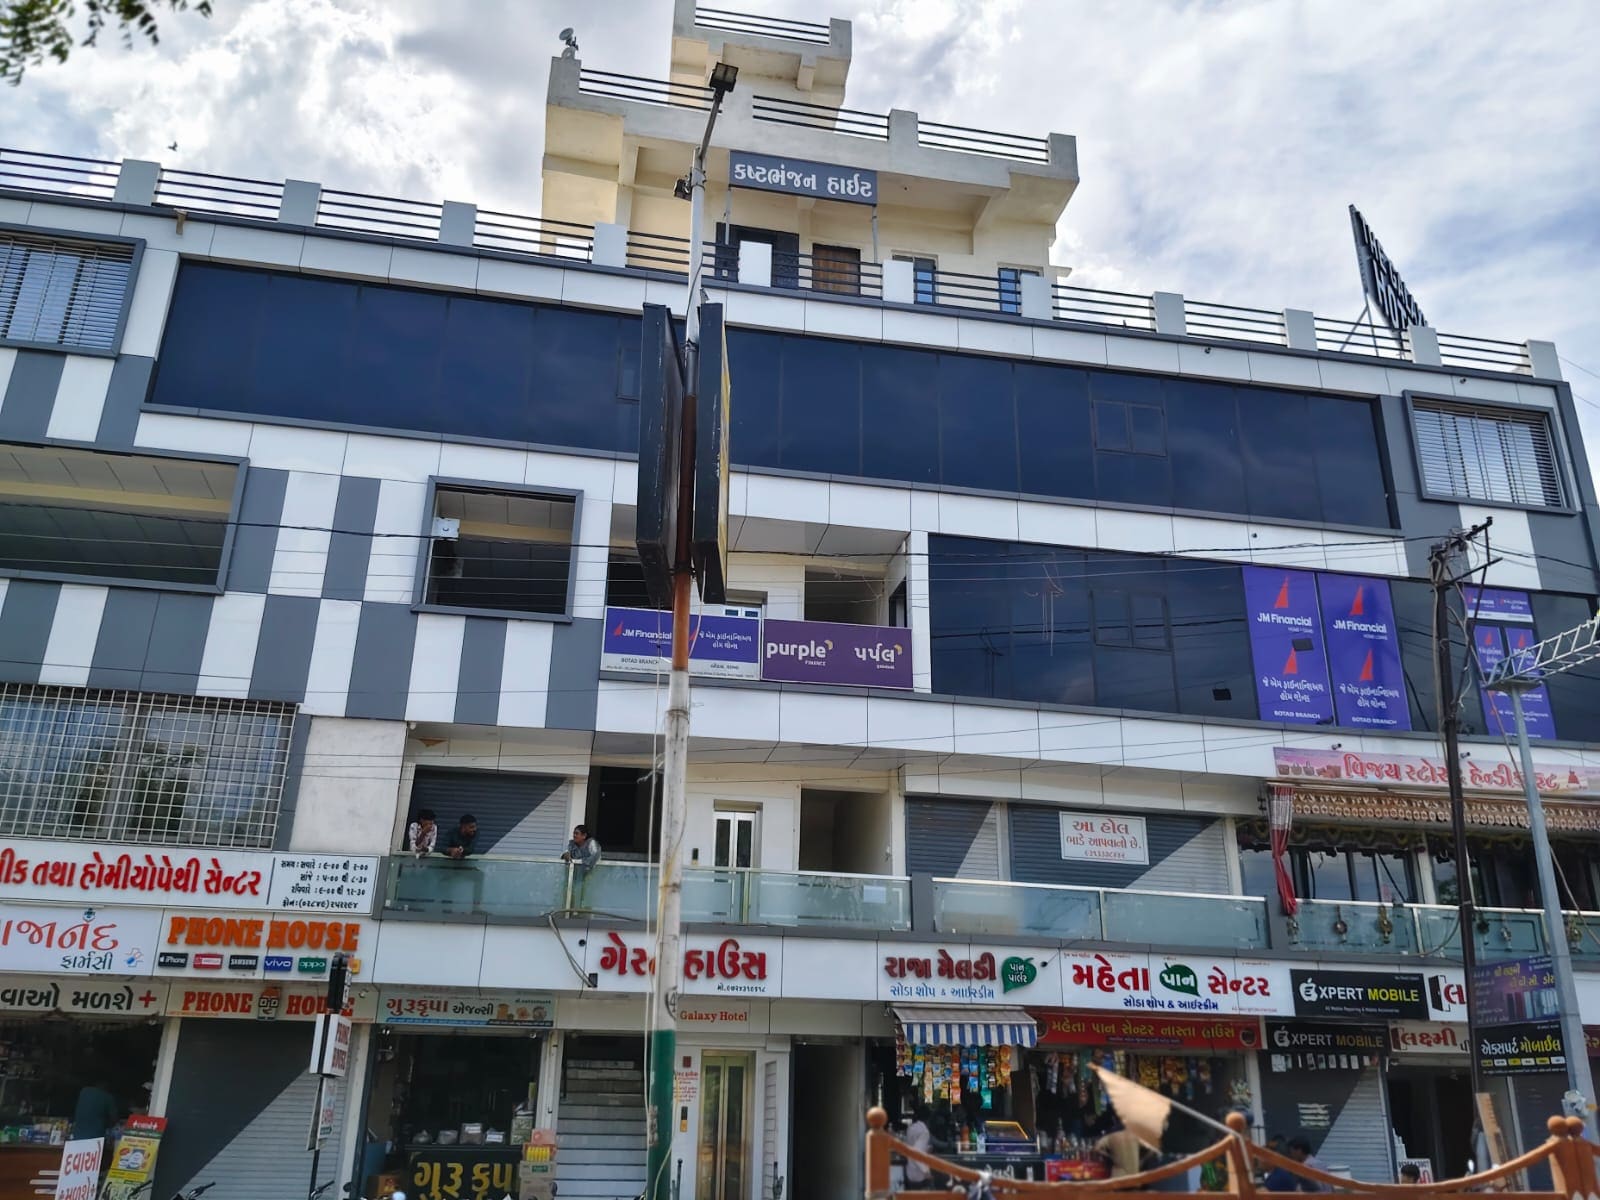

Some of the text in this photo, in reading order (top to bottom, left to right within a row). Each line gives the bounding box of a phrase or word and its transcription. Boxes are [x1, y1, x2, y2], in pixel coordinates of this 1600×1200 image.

[1257, 612, 1312, 627] JM Financial
[1333, 620, 1387, 634] JM Financial
[622, 629, 672, 640] JM Financial
[766, 640, 826, 660] purple
[854, 643, 895, 663] પર્પલ
[1343, 753, 1401, 781] વિજય
[1072, 820, 1095, 832] આ
[32, 860, 77, 887] તથા
[80, 851, 201, 893] હોમીયોપેથી
[203, 858, 262, 896] સેન્ટર
[167, 916, 361, 951] PHONE HOUSE
[61, 951, 113, 970] ફાર્મસી
[265, 960, 292, 968] vivo
[683, 938, 767, 980] હાઉસ
[884, 949, 1025, 980] રાજા મેલડી પાન
[1072, 953, 1270, 997] મહેતા પાન સેન્ટર
[71, 985, 134, 1011] મળશે
[915, 983, 935, 998] શોપ
[1367, 988, 1420, 1002] MOBILE
[182, 991, 355, 1016] PHONE HOUE
[1167, 1000, 1174, 1008] &
[680, 1010, 748, 1023] Galaxy Hotel
[1052, 1019, 1085, 1032] મહેતા
[1092, 1022, 1116, 1034] પાન
[1121, 1020, 1155, 1036] સેન્ટર
[1161, 1026, 1196, 1038] નાસ્તા
[1335, 1034, 1384, 1048] MOBILE
